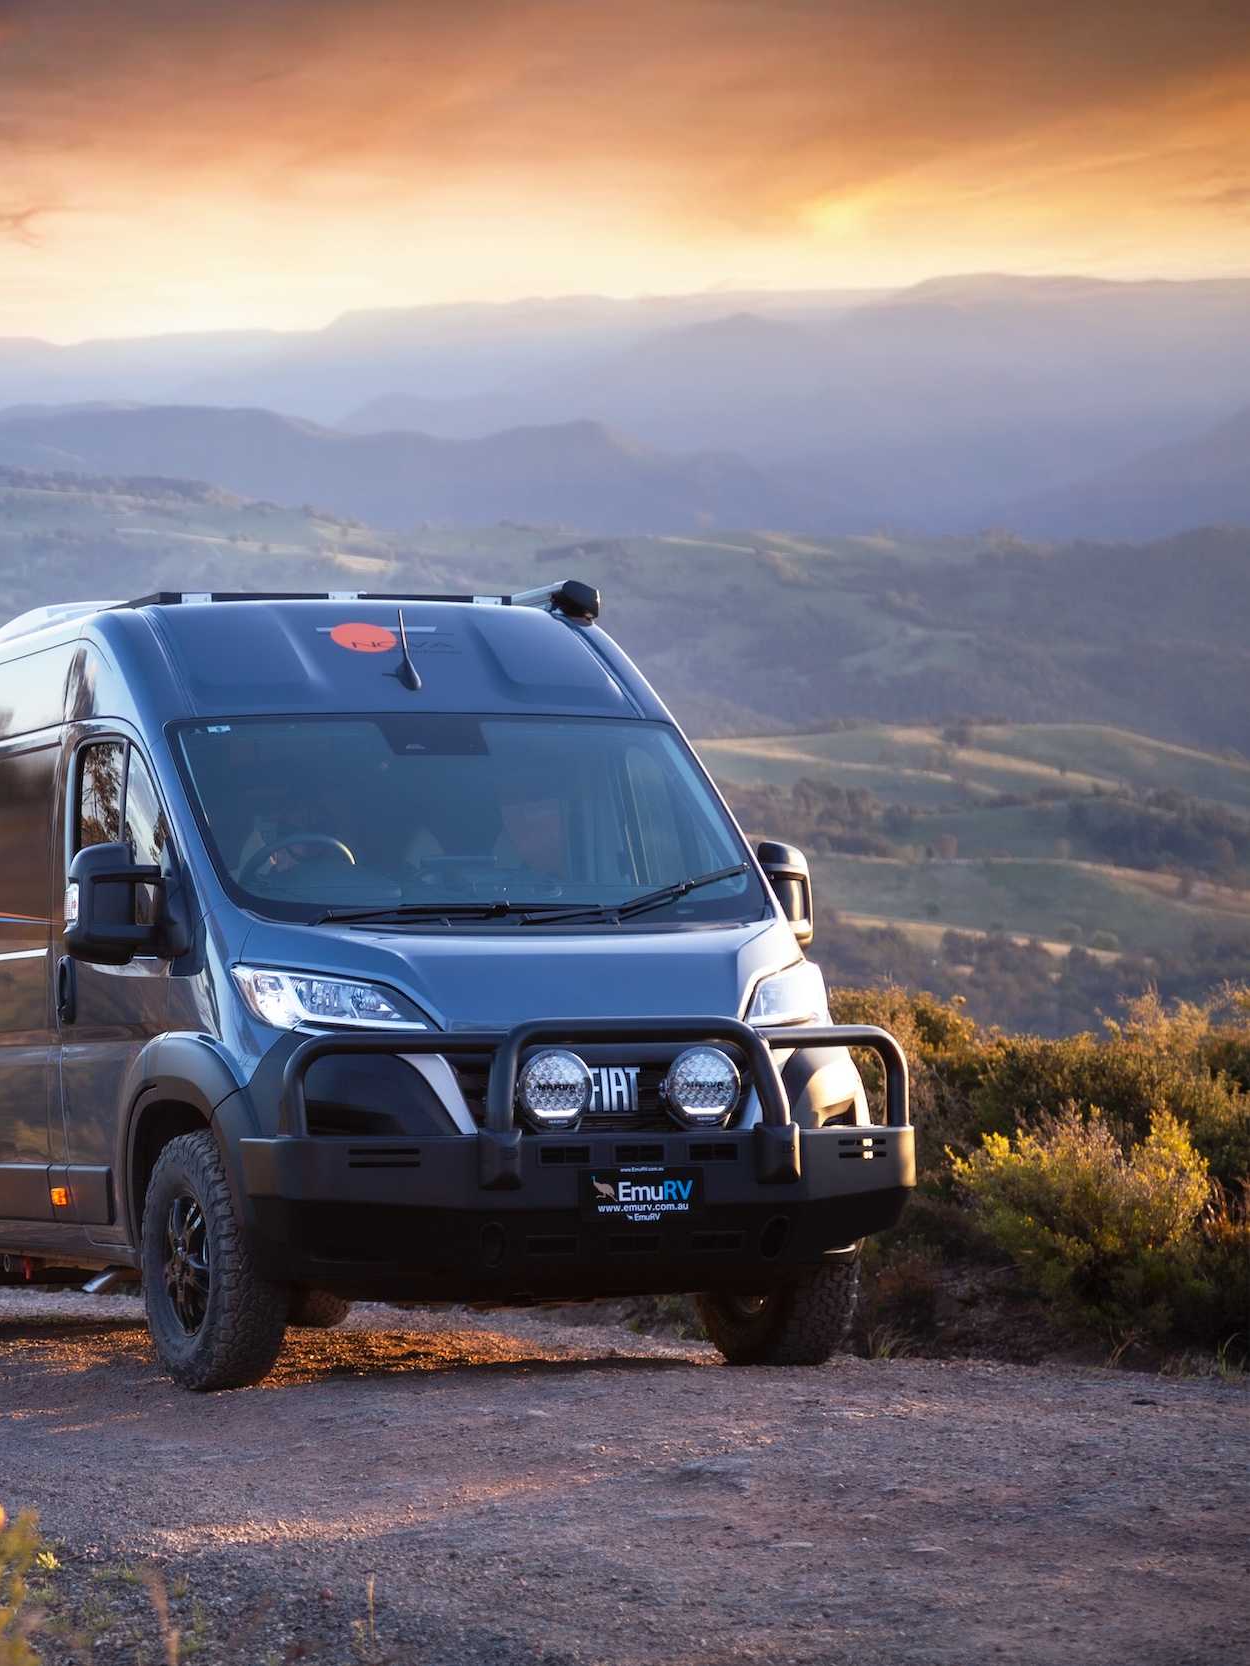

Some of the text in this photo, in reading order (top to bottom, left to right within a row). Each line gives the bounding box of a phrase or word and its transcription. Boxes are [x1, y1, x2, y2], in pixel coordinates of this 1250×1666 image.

[589, 1067, 640, 1111] FIAT
[618, 1179, 693, 1201] EmuRV
[598, 1203, 689, 1213] www.emurv.com.au
[634, 1213, 661, 1221] EmuRV
